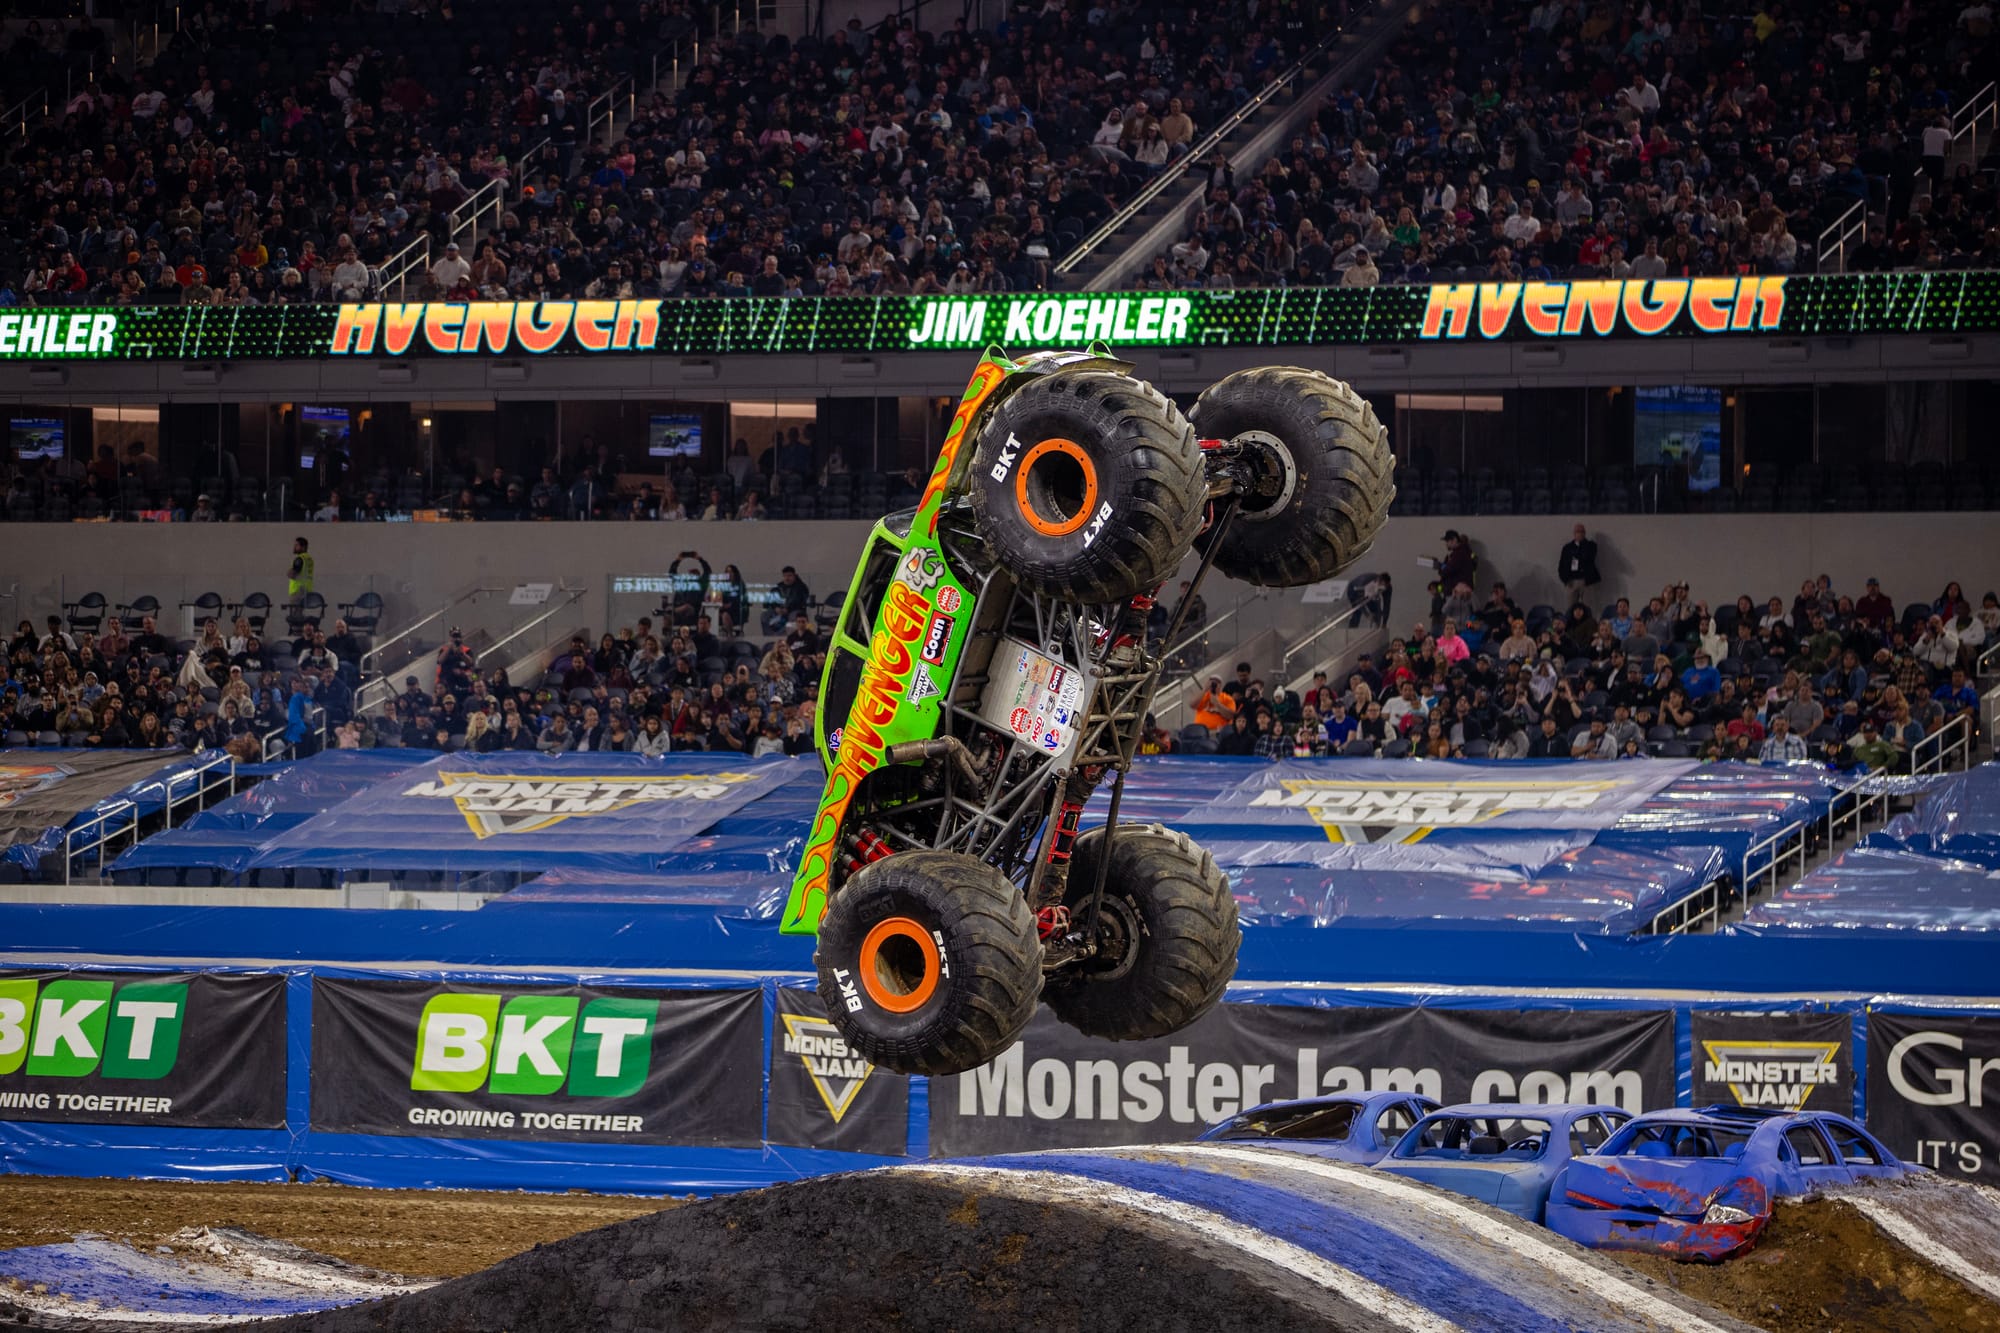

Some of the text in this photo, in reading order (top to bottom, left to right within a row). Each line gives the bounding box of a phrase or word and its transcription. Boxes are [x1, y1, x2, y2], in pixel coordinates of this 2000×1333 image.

[908, 297, 1191, 343] JIM KOEHLER
[990, 431, 1022, 483] BKT
[1082, 500, 1114, 548] BKT
[923, 618, 946, 660] Coan
[839, 580, 931, 781] AVENGER
[1049, 669, 1062, 691] Coan
[1031, 716, 1043, 743] MSD
[1044, 733, 1058, 748] VP
[402, 781, 728, 800] MONSTER
[1249, 789, 1601, 809] MONSTER
[465, 797, 620, 813] JAM
[1318, 806, 1482, 824] JAM
[932, 930, 950, 979] BKT
[832, 967, 863, 1013] BKT
[421, 1012, 648, 1078] BKT
[784, 1032, 860, 1058] MONS
[812, 1057, 865, 1079] JAM
[1704, 1061, 1838, 1084] MONSTER
[959, 1042, 1642, 1133] MonsterJmcom
[1742, 1083, 1801, 1105] JAM
[56, 1094, 173, 1113] TOGETHER
[408, 1107, 644, 1132] GROWING TOGETHER
[1916, 1139, 1982, 1174] IT'S
